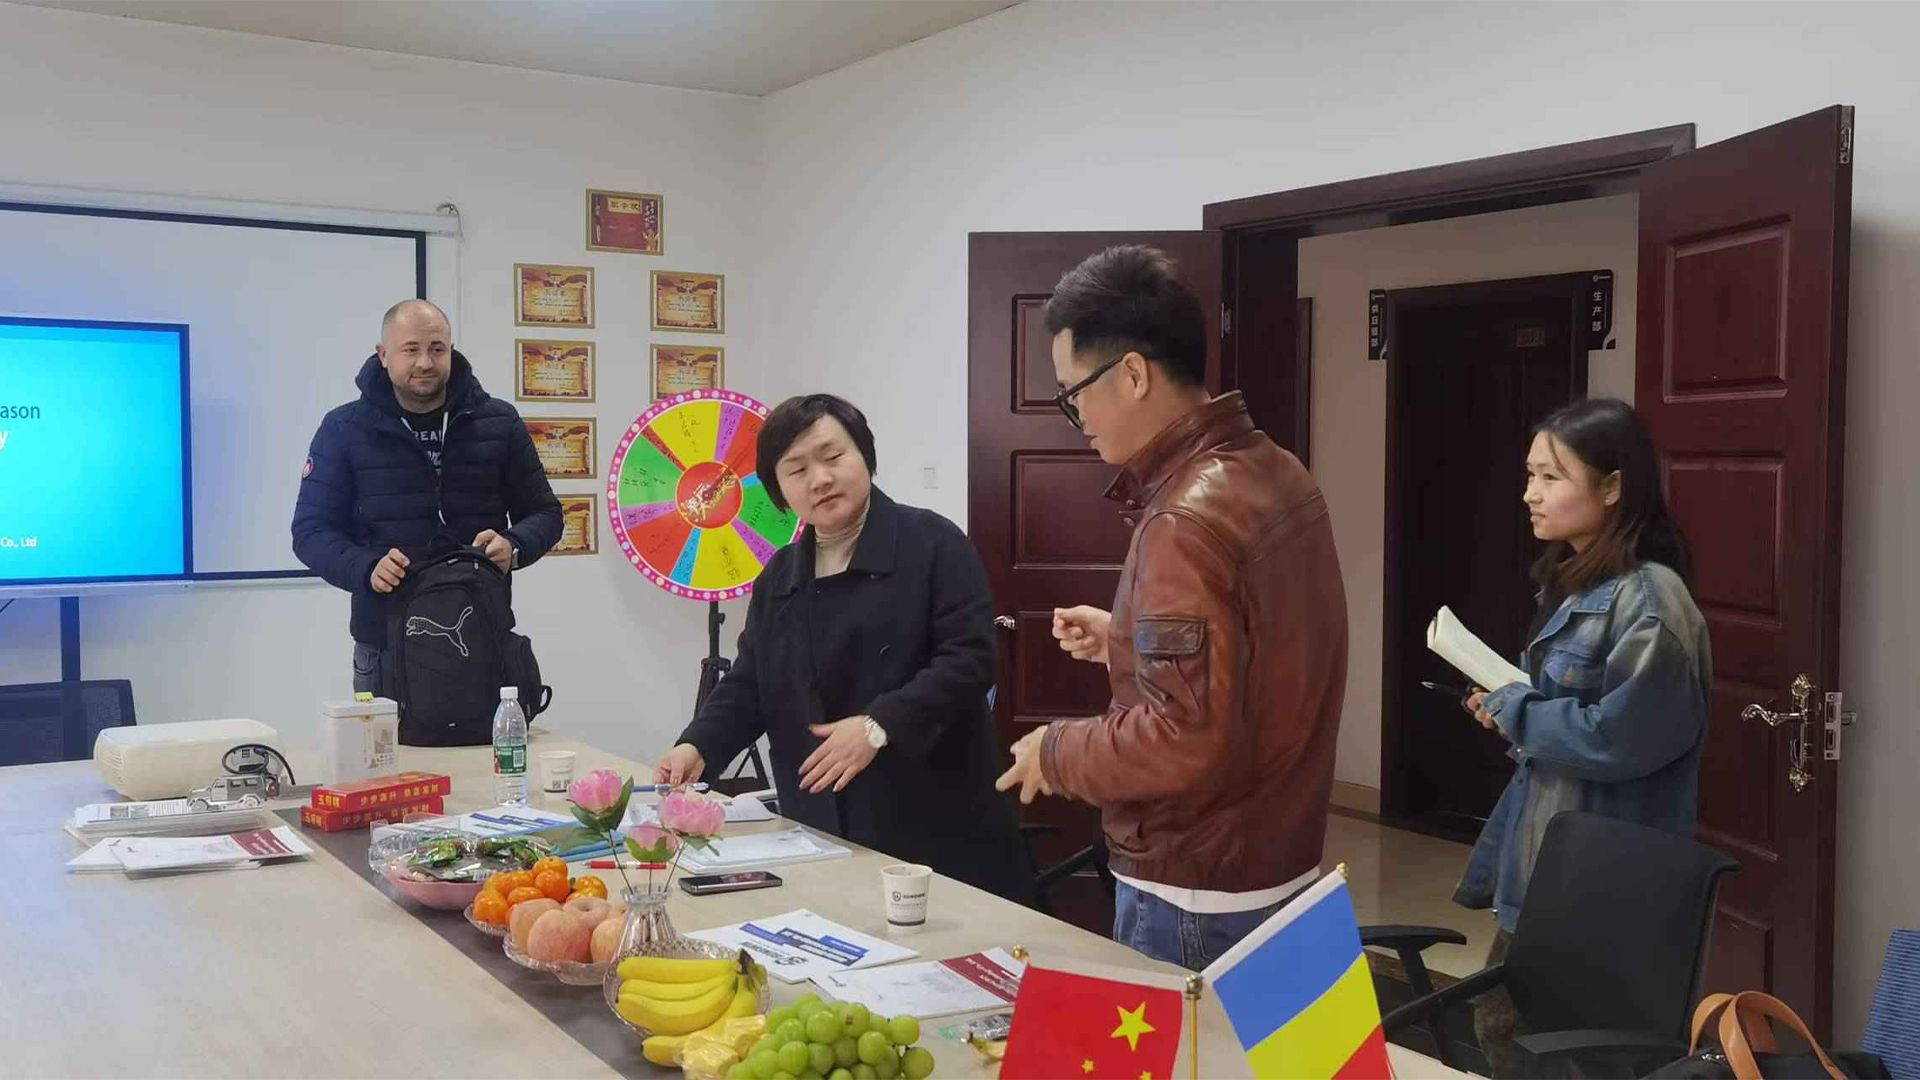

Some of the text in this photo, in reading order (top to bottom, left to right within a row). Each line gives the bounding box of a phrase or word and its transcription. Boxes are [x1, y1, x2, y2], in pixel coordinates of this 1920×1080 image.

[1592, 290, 1603, 332] 生产部
[21, 536, 37, 547] Ltd
